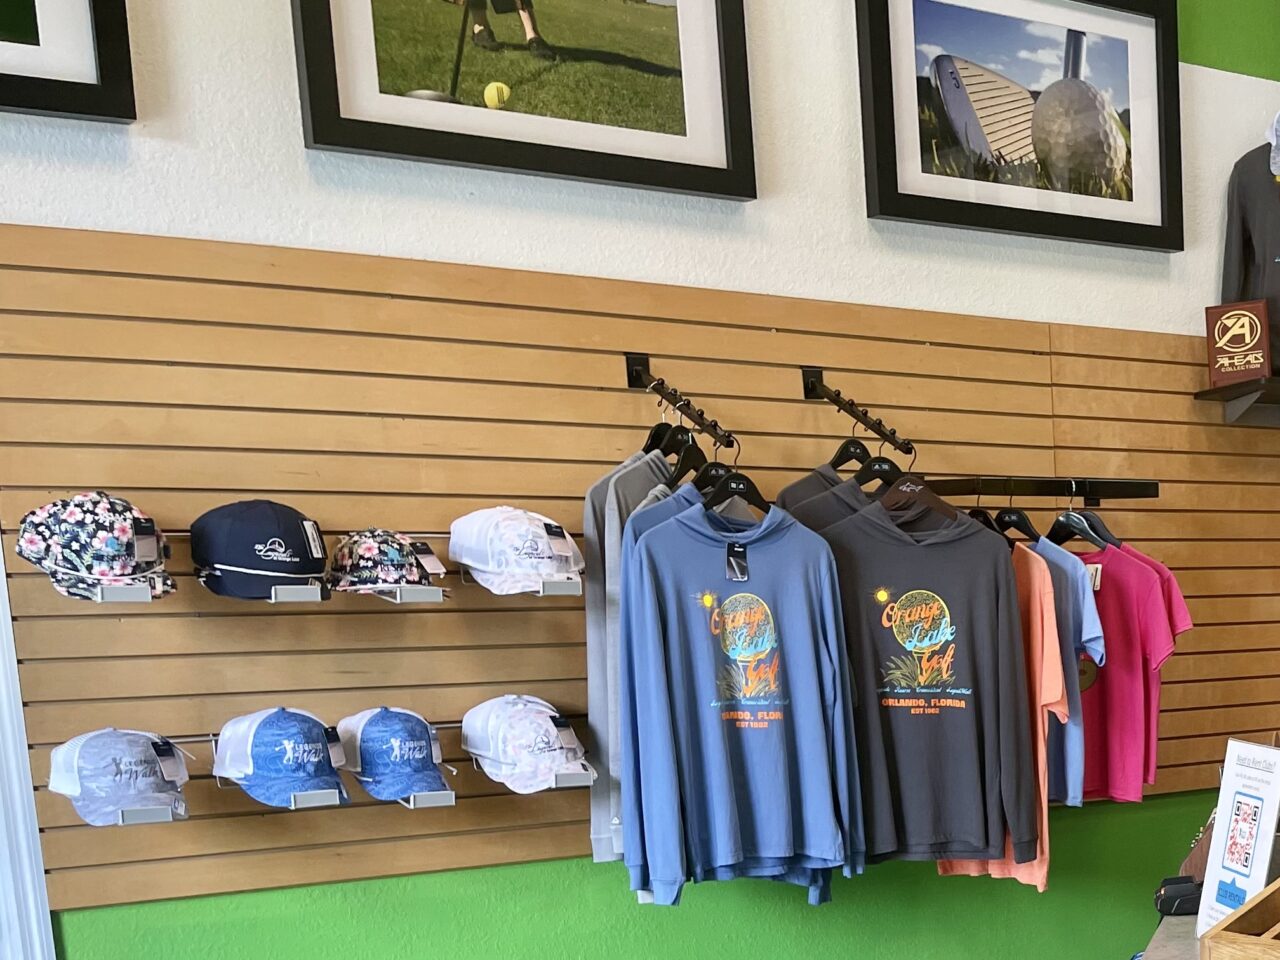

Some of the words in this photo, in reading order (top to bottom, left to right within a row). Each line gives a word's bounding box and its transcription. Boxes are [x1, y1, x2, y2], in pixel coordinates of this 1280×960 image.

[1221, 363, 1261, 373] COLLECTION
[882, 602, 941, 629] Orange
[905, 617, 956, 652] Lake
[918, 643, 956, 687] Golf
[881, 698, 928, 708] ORLANDO,
[930, 698, 966, 709] FLORIDA
[295, 748, 324, 764] Walk
[401, 747, 428, 761] Walk
[125, 766, 160, 782] Walk
